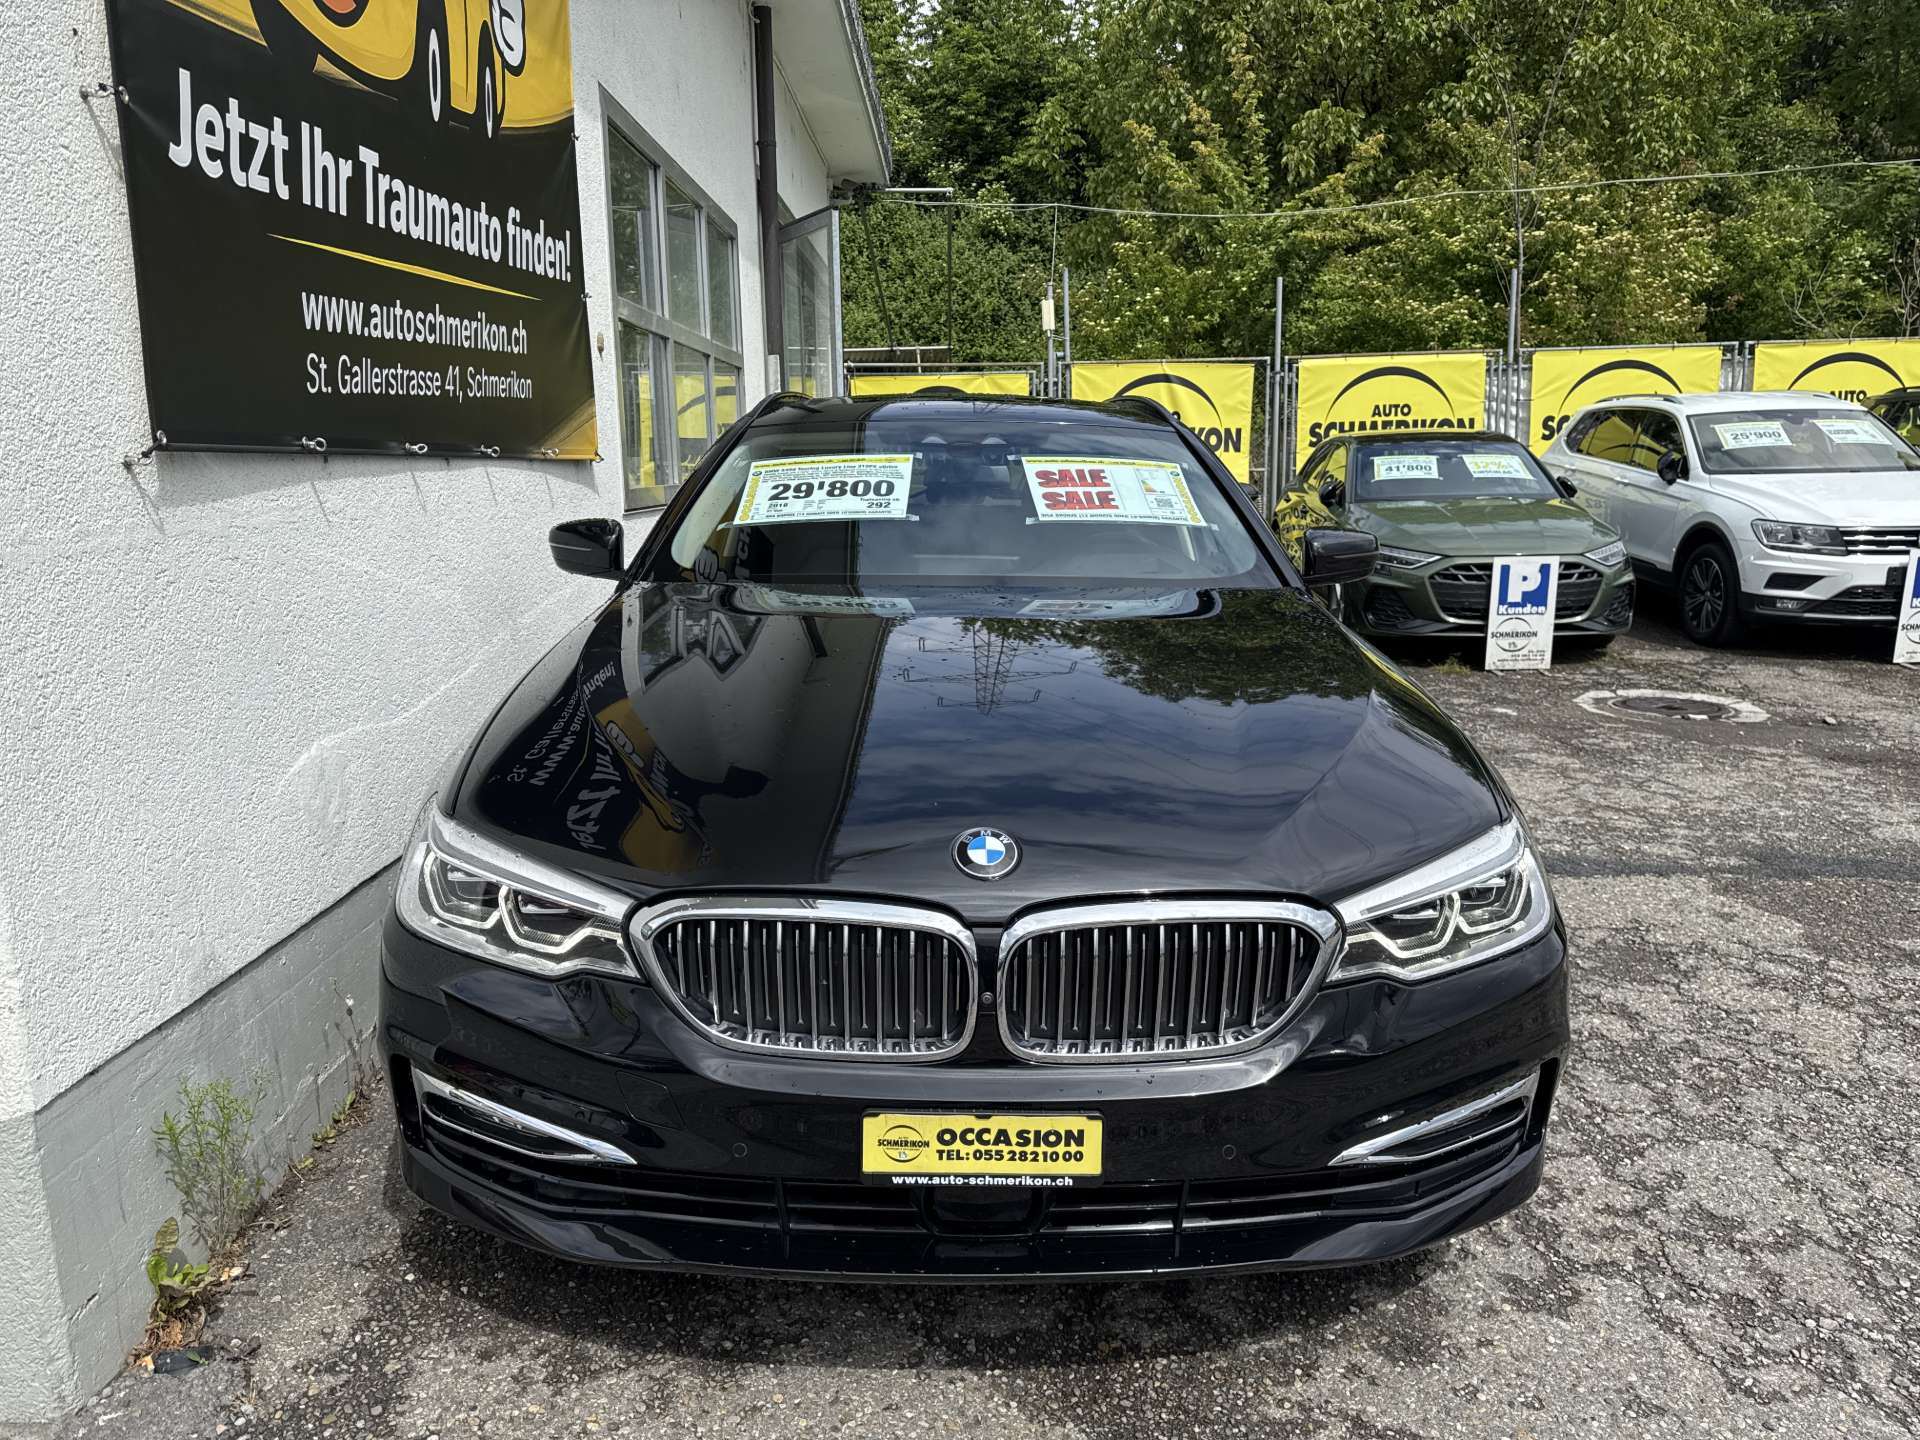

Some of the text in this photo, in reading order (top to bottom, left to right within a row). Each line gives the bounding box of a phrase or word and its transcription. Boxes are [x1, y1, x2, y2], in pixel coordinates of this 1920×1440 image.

[168, 67, 571, 283] Jetzt Ihr Traumauto finden!
[301, 291, 528, 355] www.autoschmerikon.ch
[306, 352, 533, 403] St. Gallerstrasse 41, Schmerikon
[1371, 403, 1412, 418] AUTO
[1035, 468, 1111, 488] SALE
[767, 479, 896, 502] 29'800
[1041, 490, 1120, 511] SALE
[1507, 563, 1542, 602] P
[1498, 604, 1546, 614] Kunden
[1490, 630, 1538, 639] SCHMERIKON
[963, 830, 1011, 844] BMW
[877, 1139, 930, 1148] SCHMERIKON
[936, 1127, 1085, 1148] OCCASION
[891, 1175, 1074, 1187] www.auto-schmerikon.ch
